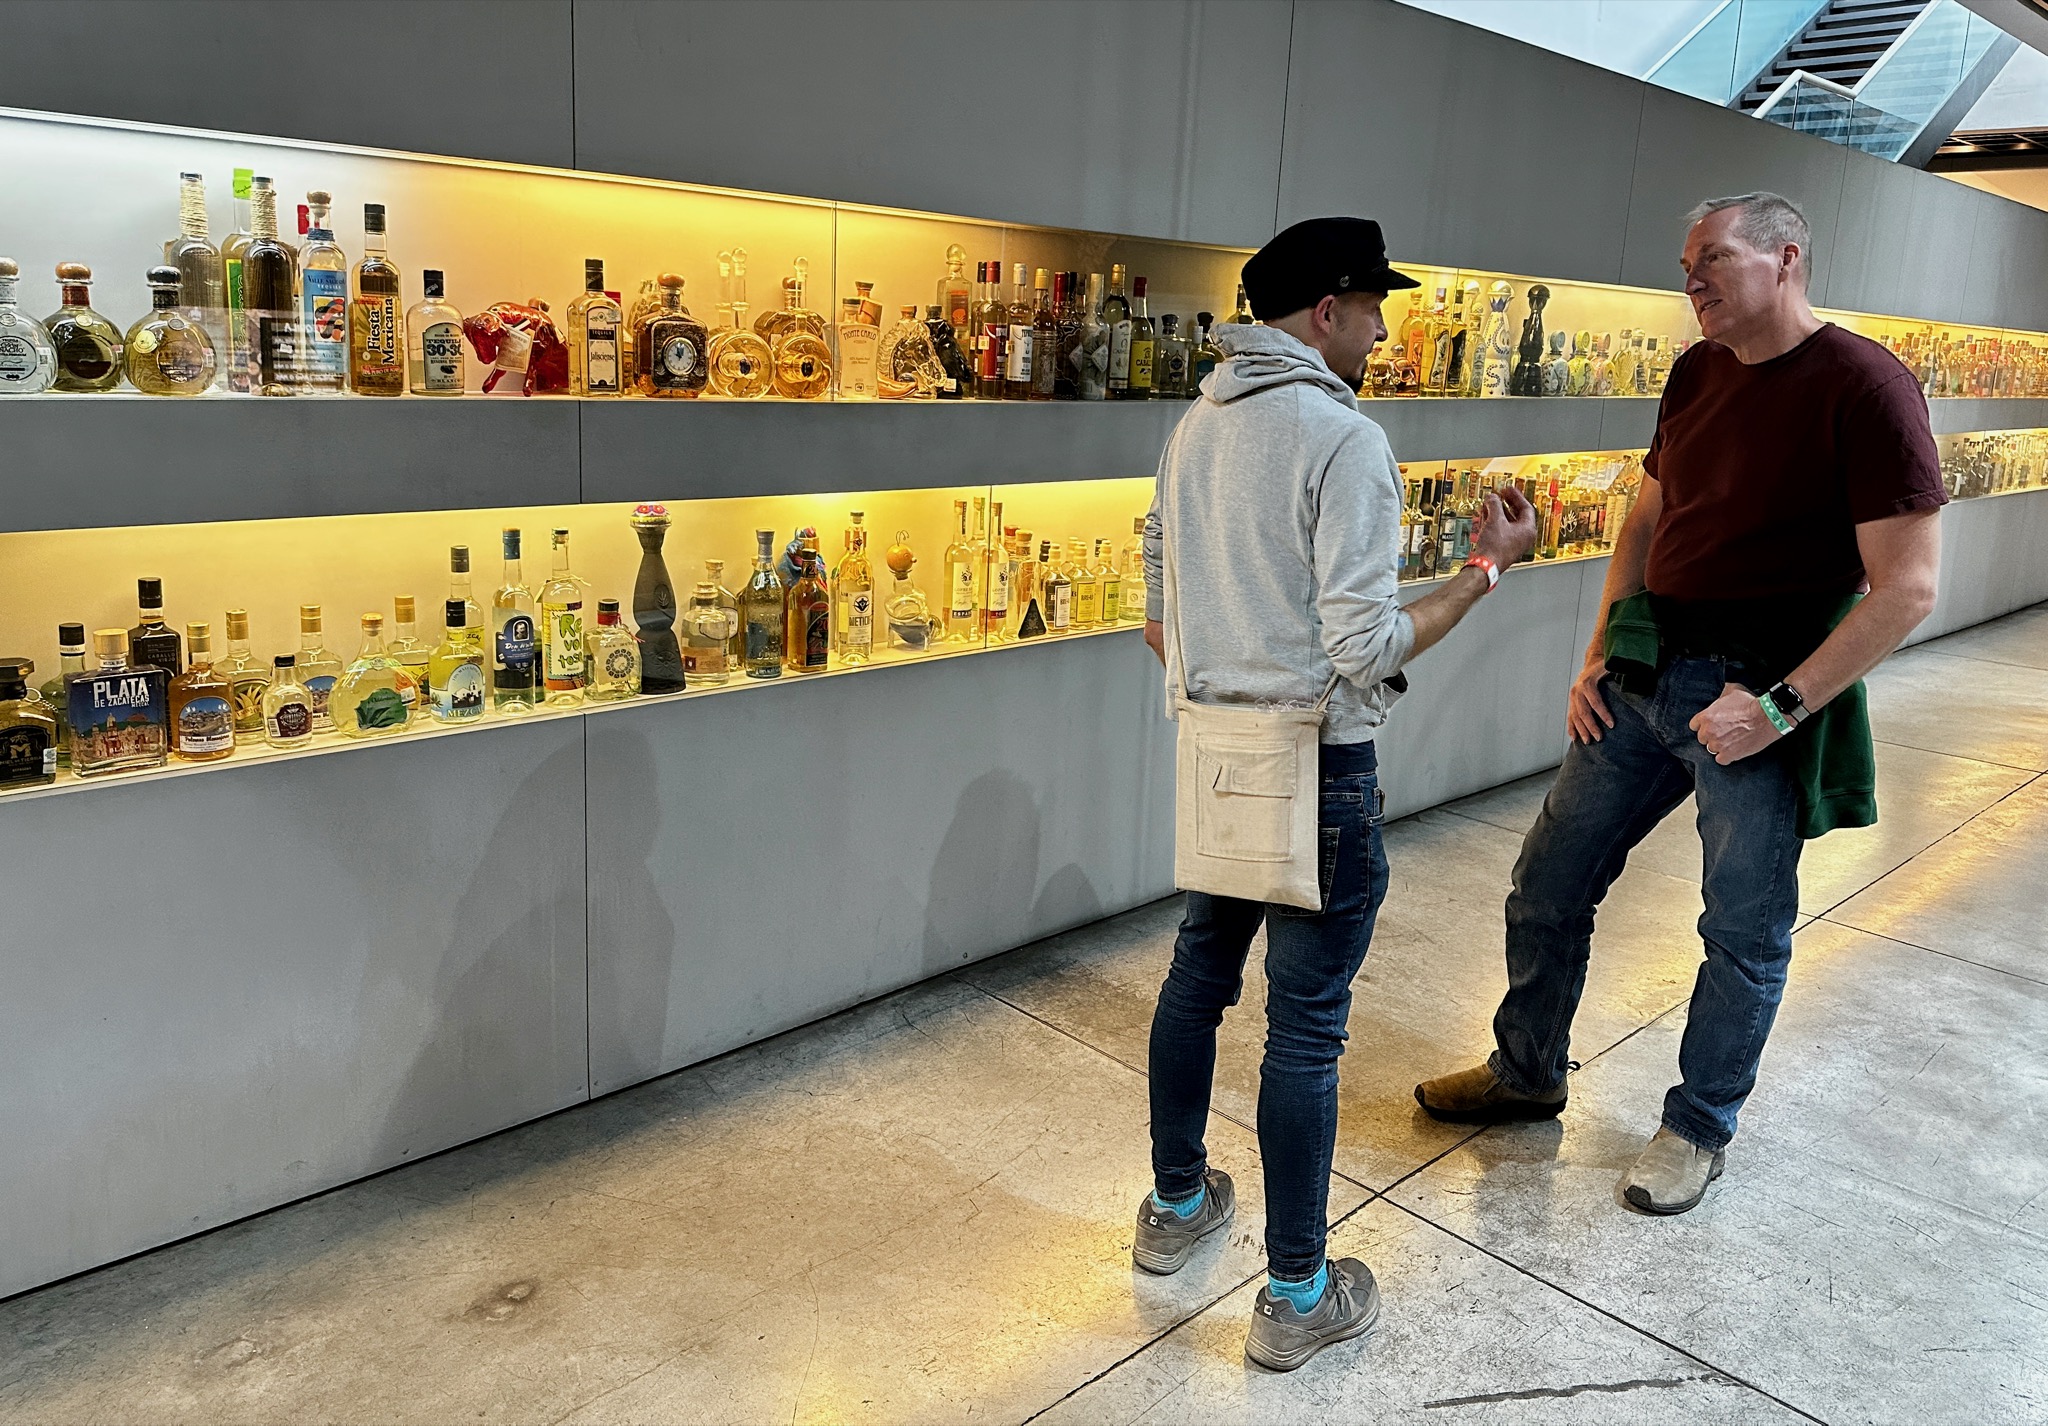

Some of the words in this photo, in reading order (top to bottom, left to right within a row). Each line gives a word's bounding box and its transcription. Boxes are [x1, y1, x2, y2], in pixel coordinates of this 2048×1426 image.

[367, 309, 381, 351] Fiesta
[381, 297, 395, 365] Mexicana
[843, 329, 860, 341] MONTE
[559, 613, 582, 639] Re
[147, 651, 176, 660] CABALLO
[93, 677, 149, 701] PLATA
[94, 699, 106, 708] DE
[108, 694, 150, 707] ZACATECAS
